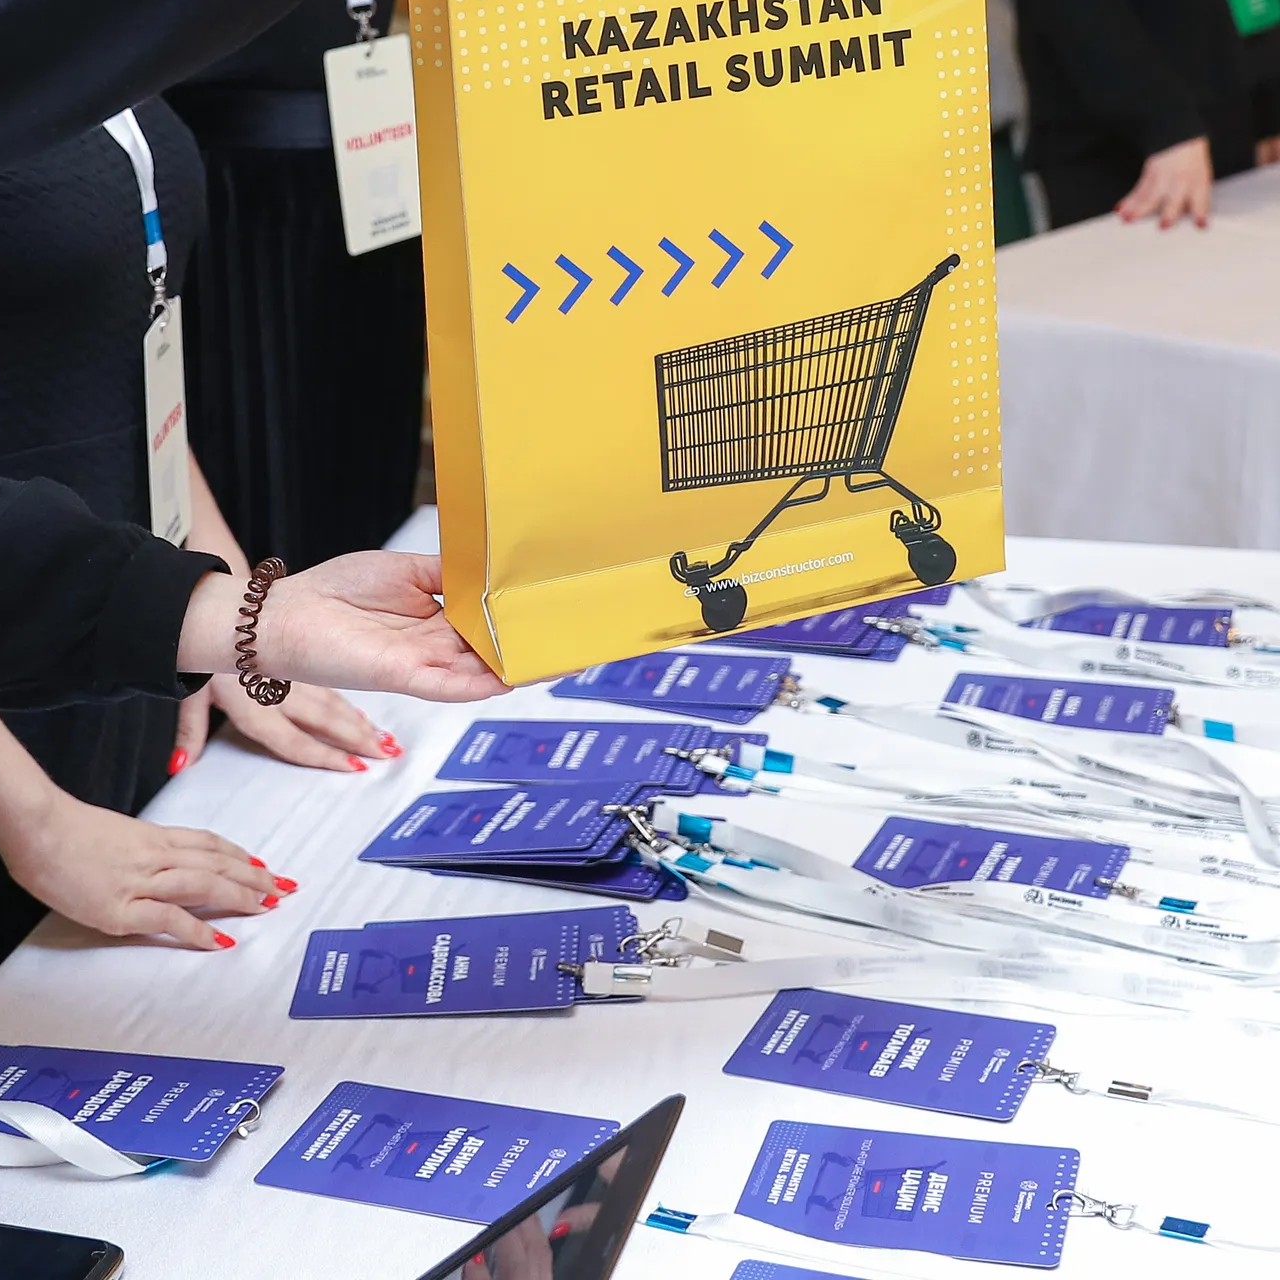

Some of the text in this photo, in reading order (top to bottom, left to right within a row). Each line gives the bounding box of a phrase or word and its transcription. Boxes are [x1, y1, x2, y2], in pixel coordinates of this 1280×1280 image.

[541, 29, 912, 120] RETAIL SUMMIT
[706, 551, 854, 593] www.bizconstructor.com
[452, 955, 471, 982] АННА
[775, 1014, 811, 1054] KAZAKHSTAN
[777, 1009, 800, 1030] RETAIL
[760, 1030, 785, 1055] SUMMIT
[869, 1023, 915, 1078] ТОГАМБАЕВ
[898, 1037, 931, 1071] БЕРИК
[938, 1038, 973, 1083] PREMIUM
[71, 1070, 133, 1123] ДАВЫДОВА
[96, 1075, 154, 1123] СВЕТЛАНА
[141, 1081, 189, 1123] PREMIUM
[316, 1114, 362, 1160] KAZAKHSTAN
[325, 1108, 352, 1133] RETAIL
[301, 1132, 331, 1161] SUMMIT
[415, 1127, 468, 1179] ЧИЧУЛИН
[444, 1135, 484, 1176] ДЕНИС
[483, 1138, 530, 1188] PREMIUM
[766, 1148, 798, 1205] RETAIL SUMMIT
[782, 1154, 811, 1203] KAZAKHSTAN
[895, 1169, 923, 1212] ЦАЦИН
[922, 1171, 949, 1214] ДЕНИС
[968, 1170, 995, 1224] PREMIUM
[1023, 1191, 1036, 1210] Бизнес
